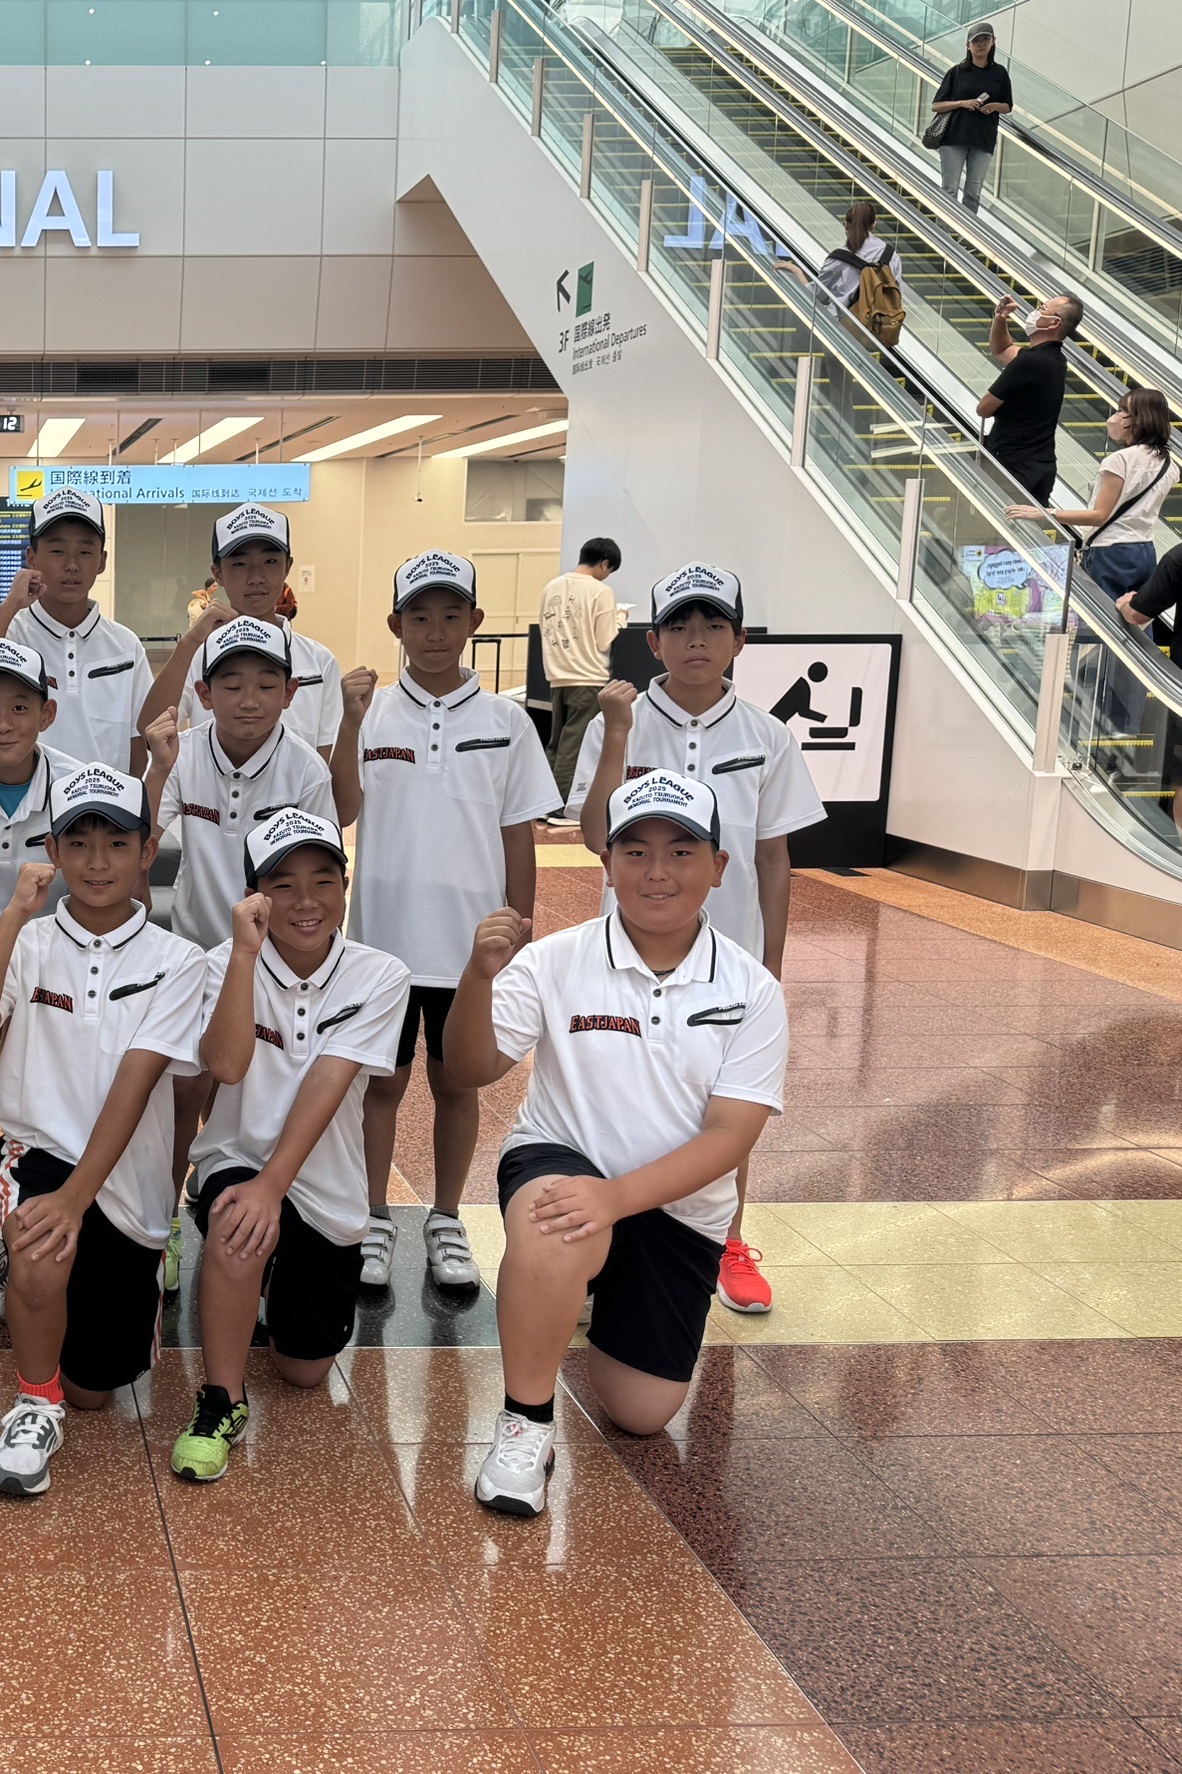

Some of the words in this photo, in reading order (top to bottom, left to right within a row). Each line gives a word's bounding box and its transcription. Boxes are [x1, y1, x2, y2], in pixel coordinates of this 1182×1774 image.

[559, 330, 569, 353] 3F
[573, 334, 610, 360] International
[611, 324, 647, 348] Departures
[50, 470, 132, 485] 国際線到着
[43, 493, 61, 510] BOYS
[62, 490, 90, 508] LEAGUE
[136, 487, 185, 499] Arrivals
[227, 512, 244, 530] BOYS
[246, 509, 274, 524] LEAGUE
[406, 559, 426, 579] BOYS
[427, 554, 460, 572] LEAGUE
[665, 571, 687, 592] BOYS
[689, 567, 724, 586] LEAGUE
[216, 624, 236, 644] BOYS
[238, 620, 271, 640] LEAGUE
[63, 772, 86, 794] BOYS
[88, 769, 125, 791] LEAGUE
[624, 780, 650, 804] BOYS
[652, 777, 694, 801] LEAGUE
[264, 817, 285, 840] BOYS
[286, 813, 324, 831] LEAGUE
[569, 1014, 642, 1038] EASTJAPAN
